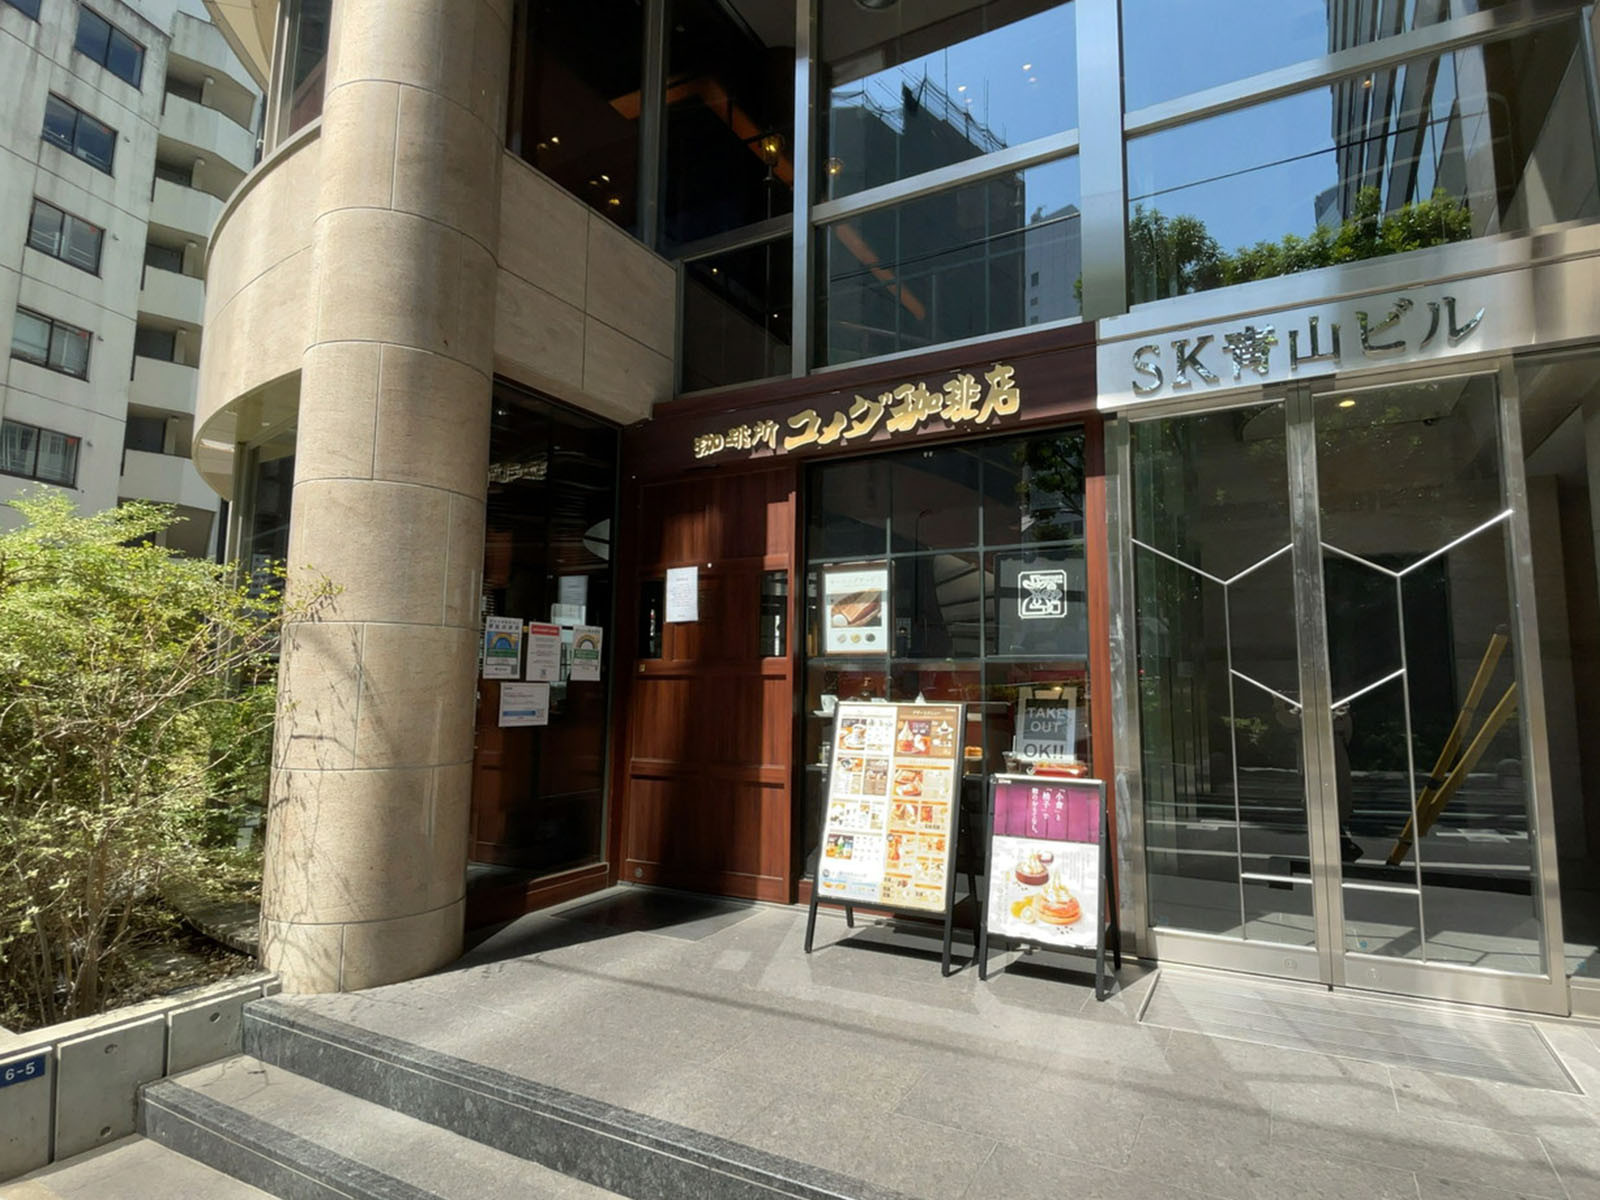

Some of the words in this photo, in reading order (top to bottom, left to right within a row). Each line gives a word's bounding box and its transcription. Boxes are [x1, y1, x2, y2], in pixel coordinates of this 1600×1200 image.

[1131, 295, 1486, 397] SK青山ビル
[1027, 707, 1067, 720] TAKE
[1030, 721, 1062, 733] OUT
[1023, 743, 1065, 760] OK!!
[5, 1062, 36, 1081] 6-5
